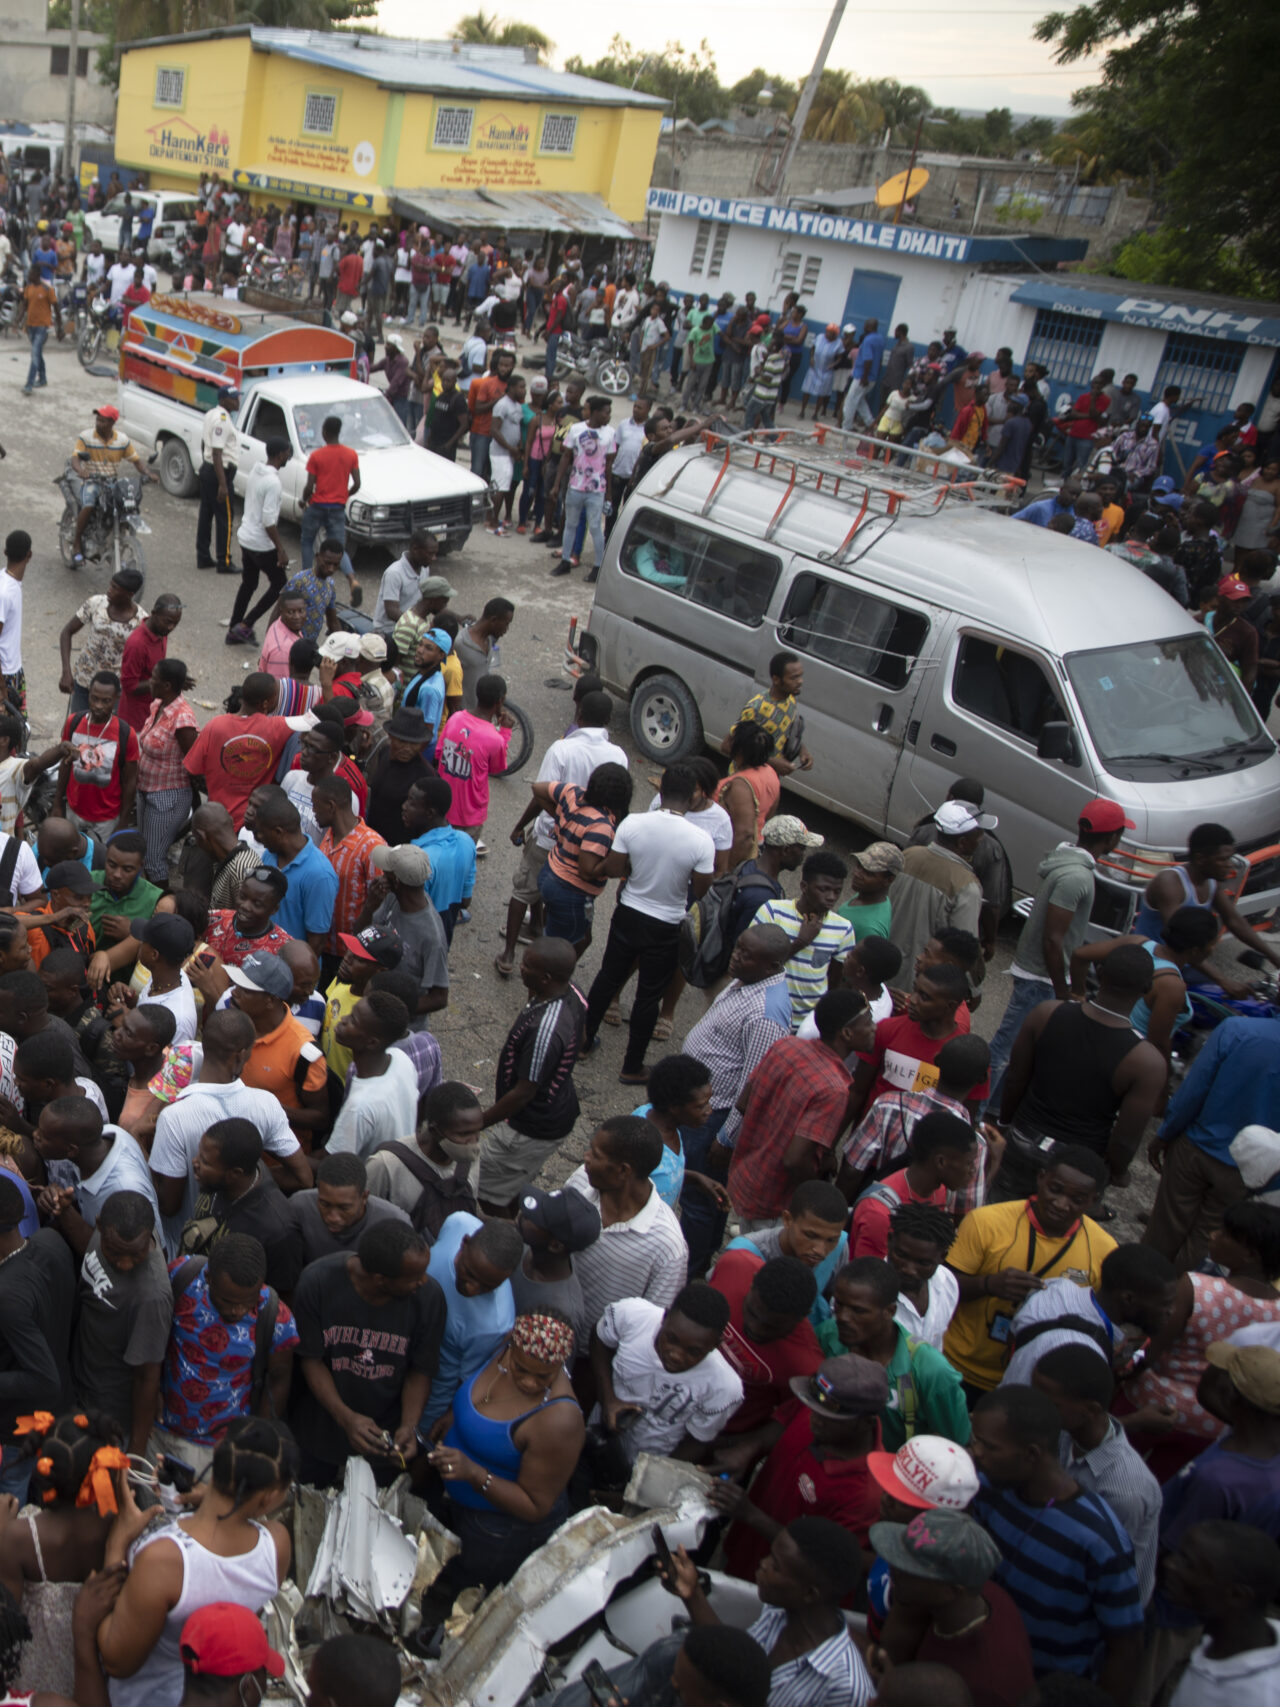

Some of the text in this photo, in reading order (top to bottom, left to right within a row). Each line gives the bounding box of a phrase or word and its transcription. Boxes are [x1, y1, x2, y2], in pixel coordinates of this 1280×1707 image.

[649, 189, 677, 210] PNH
[682, 195, 764, 226] POLICE
[768, 209, 896, 249] NATIONALE
[1052, 301, 1102, 319] POLICE
[1122, 314, 1228, 339] NATIONALE
[1116, 298, 1263, 332] PNH
